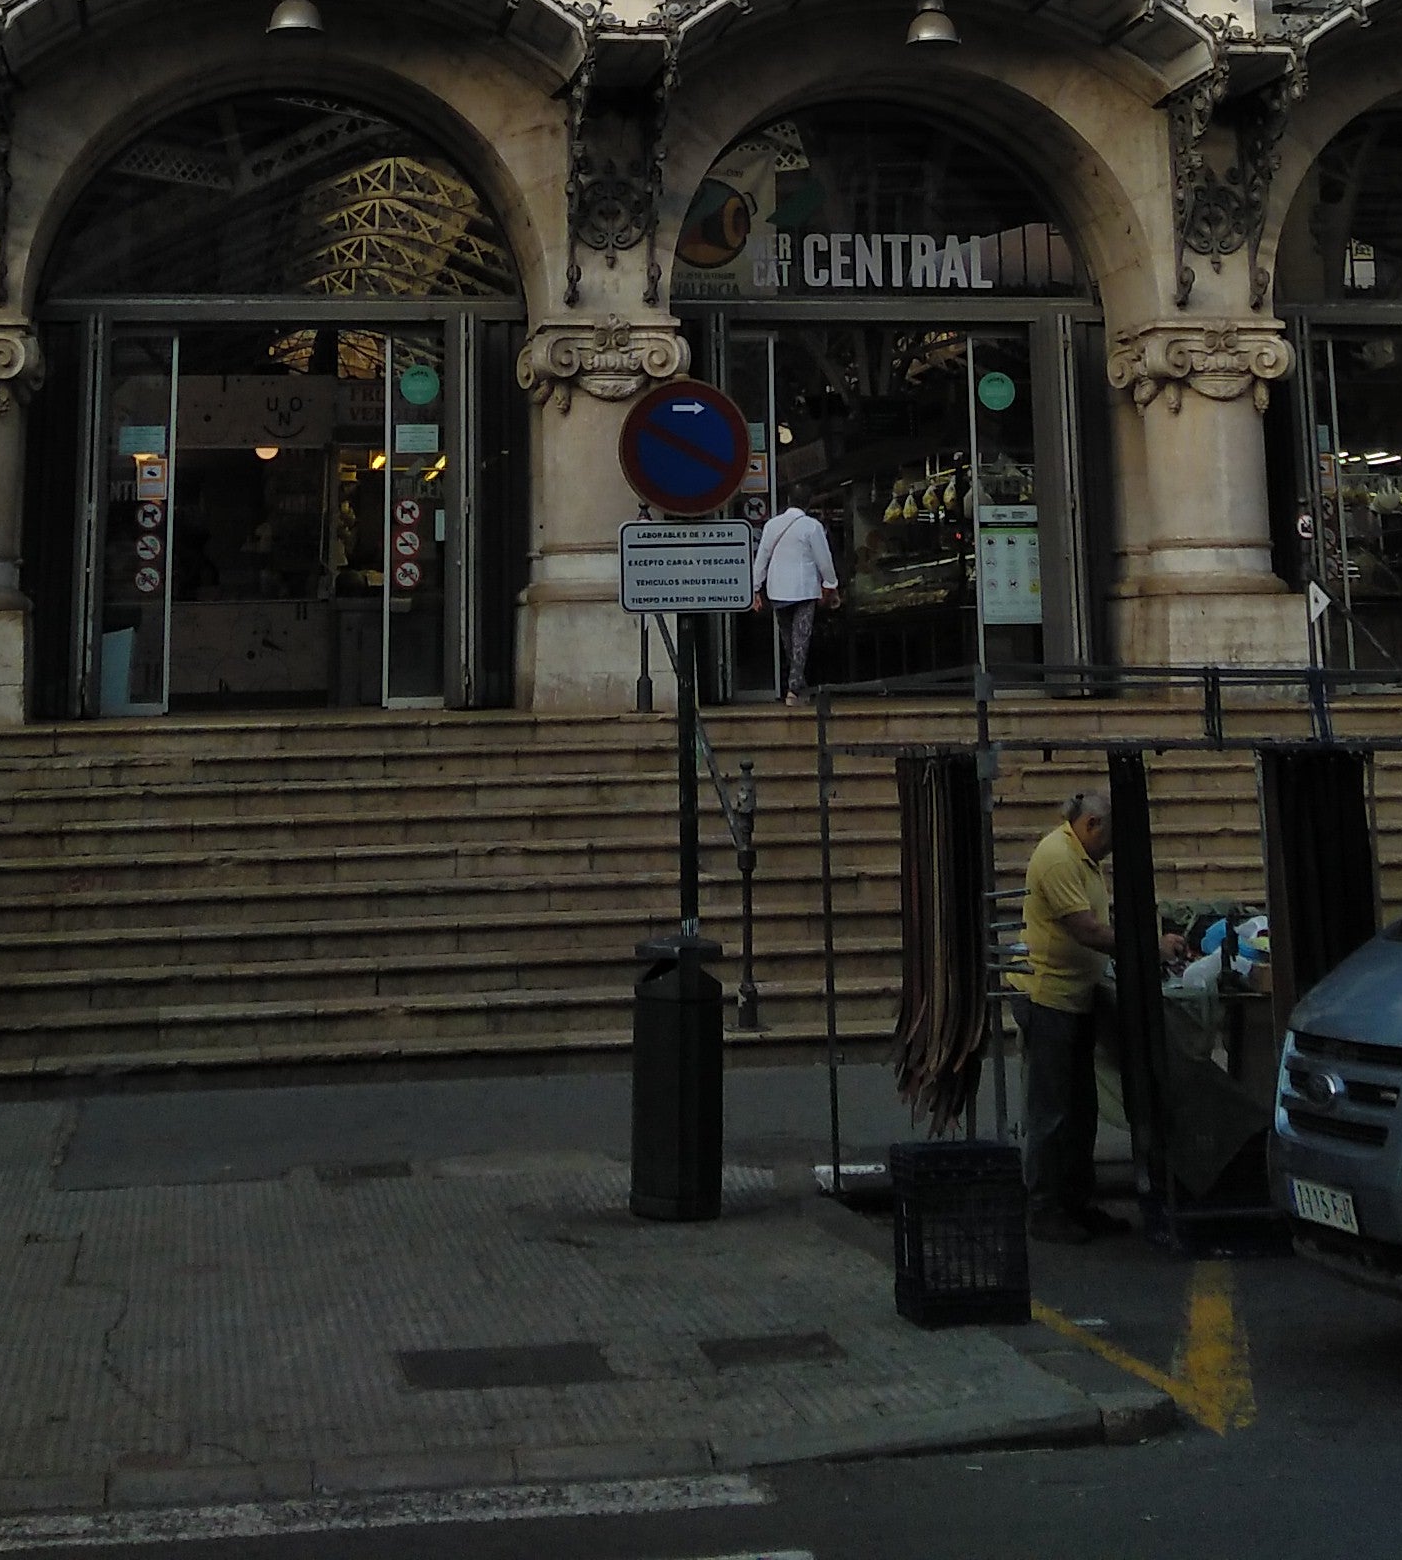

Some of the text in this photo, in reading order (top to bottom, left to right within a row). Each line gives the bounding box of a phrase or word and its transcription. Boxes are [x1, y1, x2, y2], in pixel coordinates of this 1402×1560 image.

[802, 233, 994, 289] CENTRAL
[637, 531, 687, 539] LABORABLES
[628, 559, 664, 567] EXCEPTO
[703, 558, 746, 566] DESCARGA
[636, 578, 739, 587] VEHICULOS INDUSTRIALES
[631, 597, 660, 605] TIEMPO
[709, 595, 746, 603] MINUTOS
